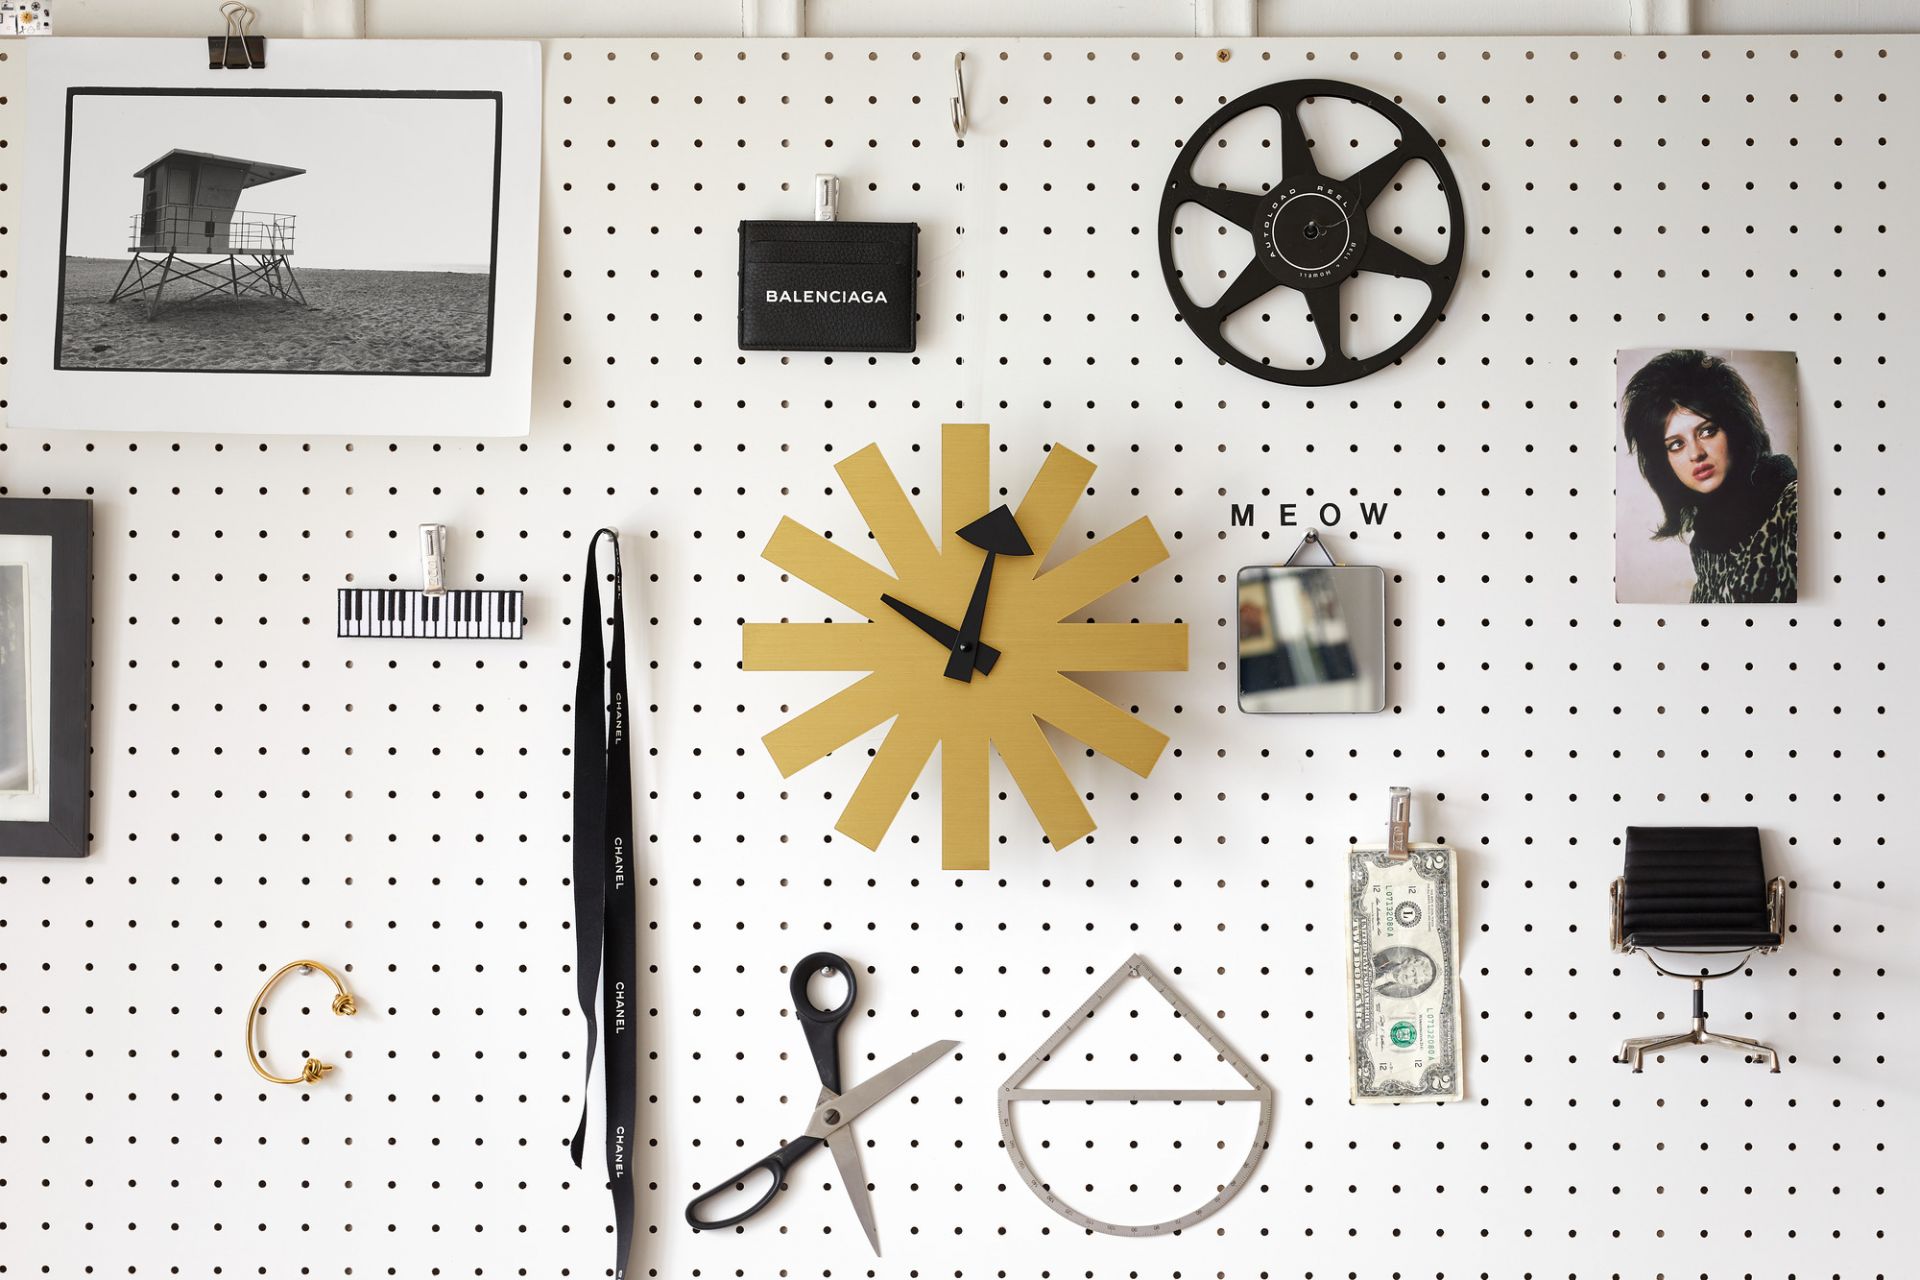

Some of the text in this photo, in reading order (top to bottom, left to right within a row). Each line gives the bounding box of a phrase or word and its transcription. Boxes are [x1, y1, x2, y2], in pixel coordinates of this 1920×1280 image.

[1263, 185, 1348, 258] AUTOLOAD REEL
[766, 290, 888, 303] BALENCIAGA
[1231, 502, 1388, 527] MEOW
[614, 836, 624, 891] CHANEL
[1373, 884, 1381, 893] 12
[1408, 885, 1416, 894] 12
[615, 981, 625, 1035] CHANEL
[1379, 1062, 1388, 1071] 12
[1414, 1059, 1423, 1068] 12
[615, 1126, 625, 1179] CHANEL
